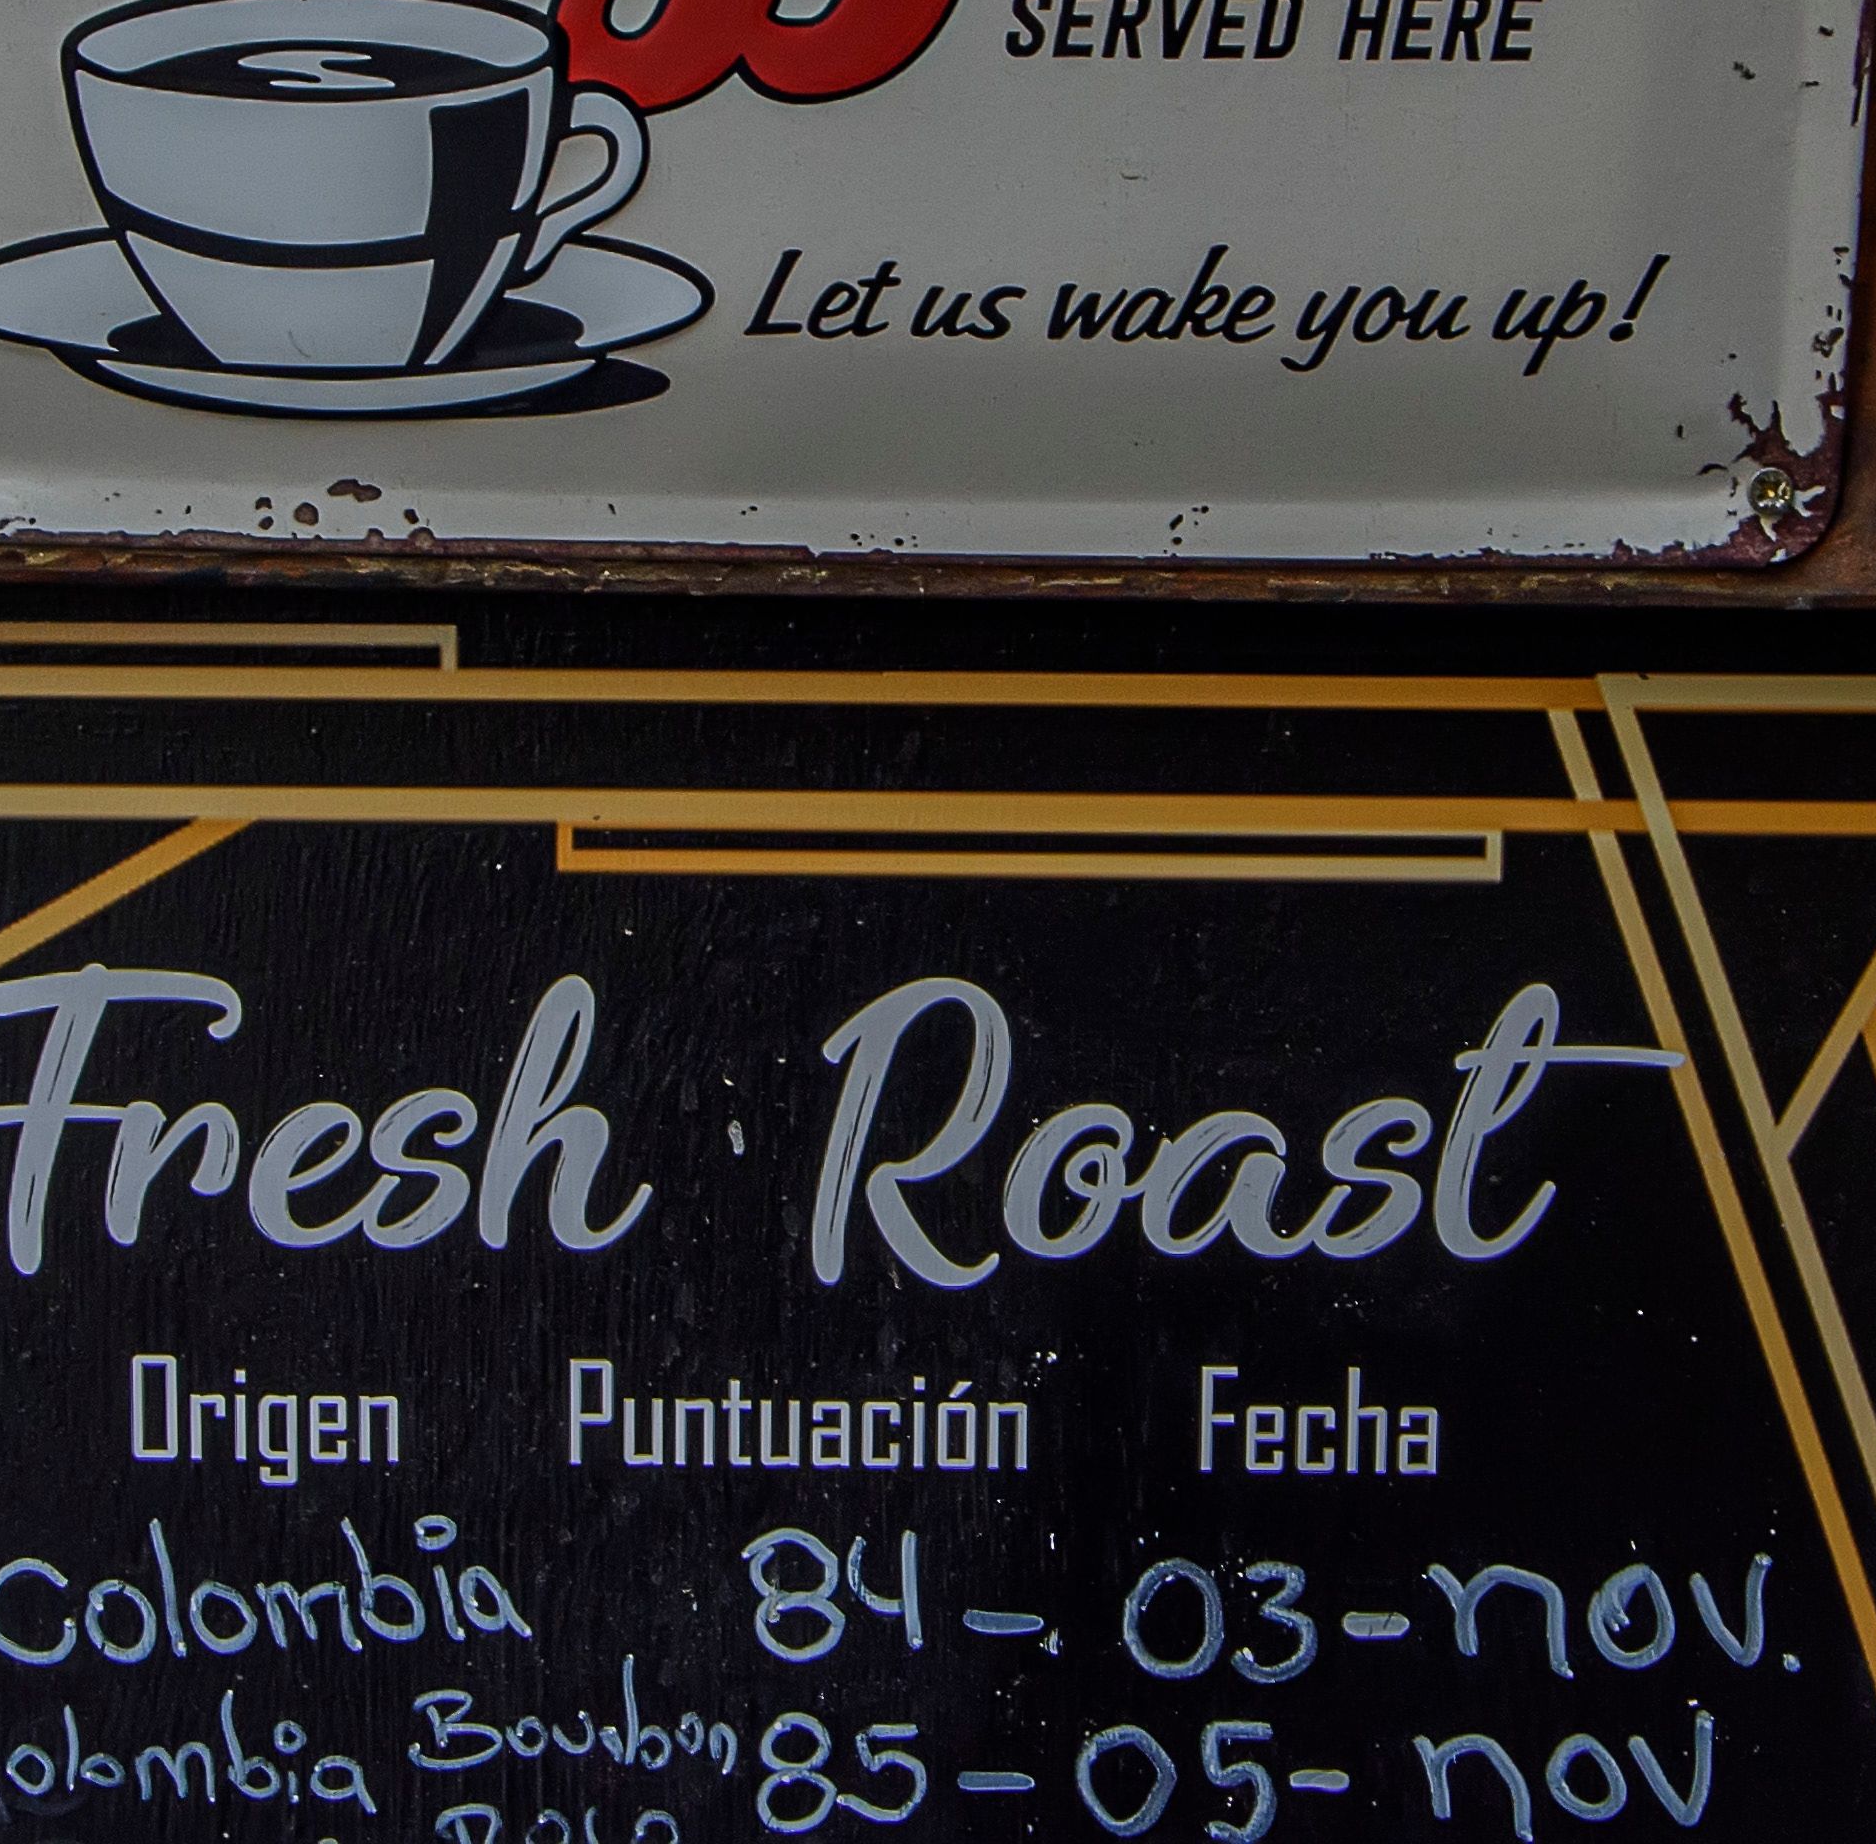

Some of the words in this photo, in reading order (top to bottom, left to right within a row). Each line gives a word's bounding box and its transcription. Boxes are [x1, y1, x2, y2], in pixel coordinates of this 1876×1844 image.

[742, 248, 902, 340] Let
[909, 285, 1028, 341] us
[1046, 243, 1277, 345] wake
[1279, 285, 1472, 374] you
[1490, 252, 1672, 378] up!
[812, 976, 1684, 1288] Roast
[130, 1353, 401, 1486] Origen
[568, 1357, 1029, 1471] Puntuación
[1199, 1365, 1439, 1475] Fecha
[756, 1711, 928, 1834] 85
